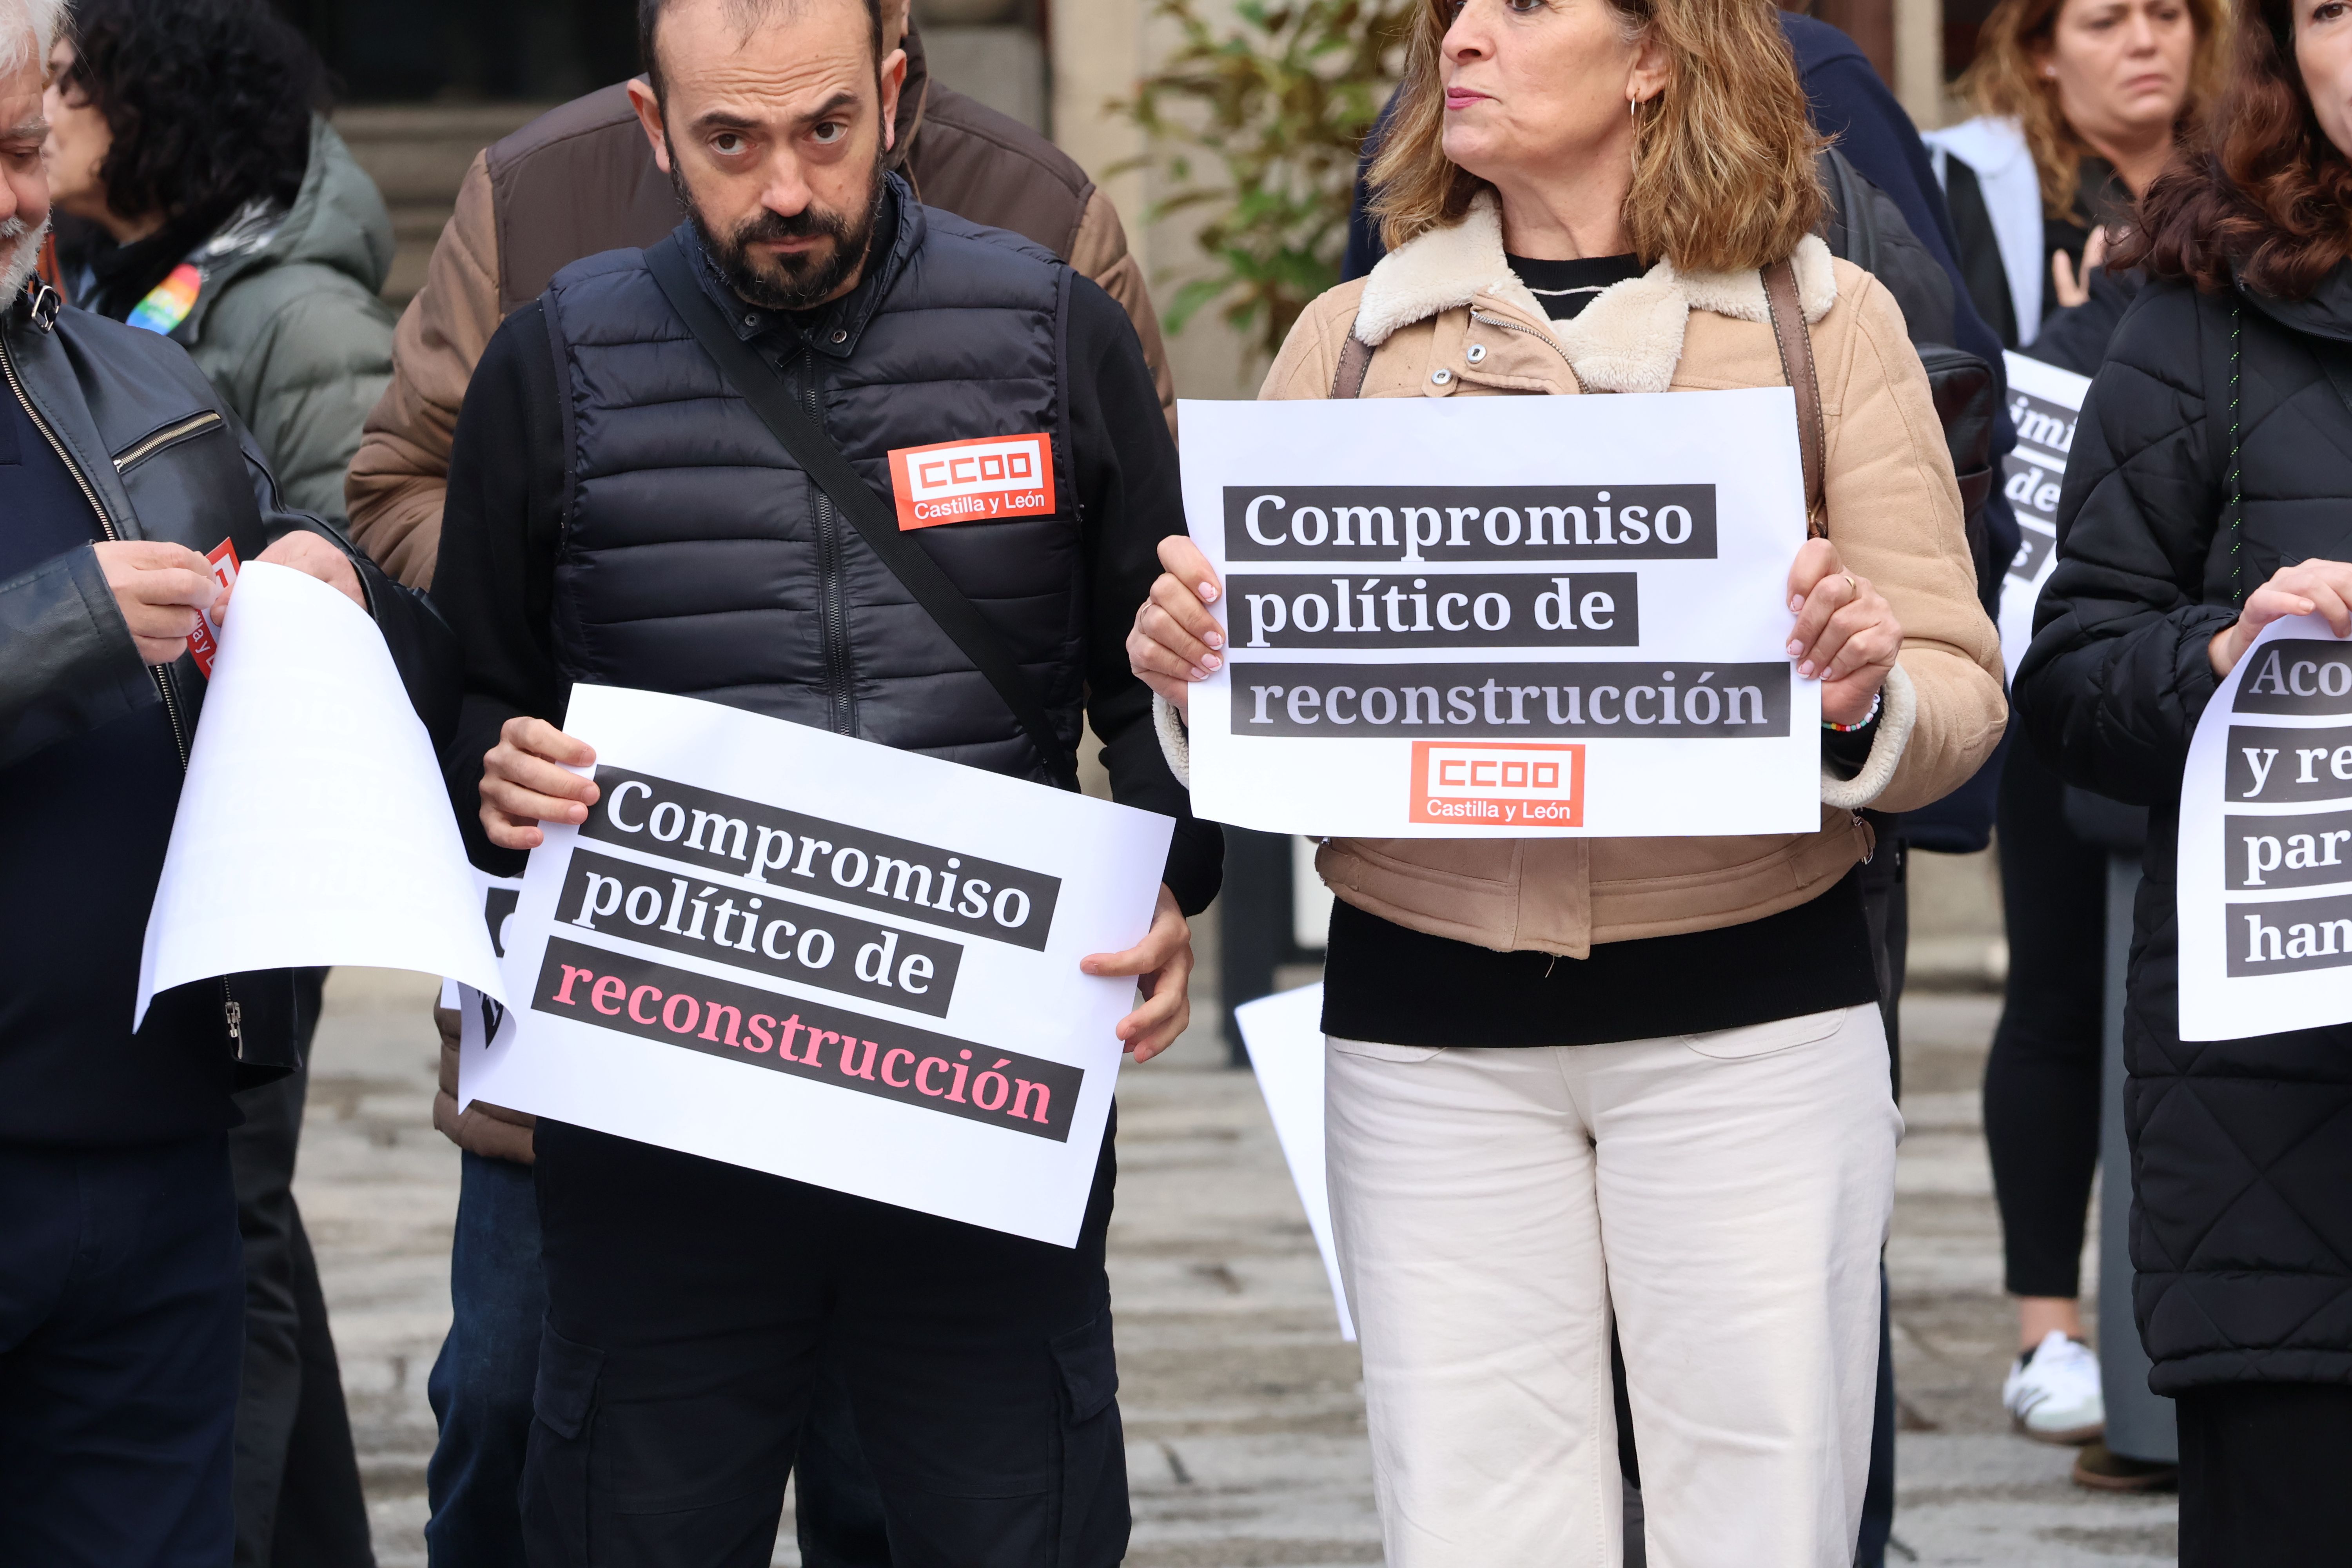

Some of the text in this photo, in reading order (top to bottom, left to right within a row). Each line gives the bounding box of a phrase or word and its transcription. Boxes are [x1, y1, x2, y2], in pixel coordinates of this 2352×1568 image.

[919, 452, 1032, 489] CCOO
[914, 491, 1044, 519] Castilla y León
[1245, 491, 1692, 561] Compromiso
[1245, 578, 1615, 647] político de
[1249, 671, 1768, 725] reconstrucción
[2249, 650, 2352, 696] Aco
[1439, 760, 1559, 788] CCOO
[2242, 746, 2352, 797] y re
[1427, 799, 1570, 822] Castilla y León
[608, 781, 1030, 927] Compromiso
[2243, 830, 2351, 885] par
[572, 871, 835, 969] político
[855, 930, 934, 994] de
[2244, 915, 2352, 962] han
[552, 964, 1051, 1124] reconstrucción
